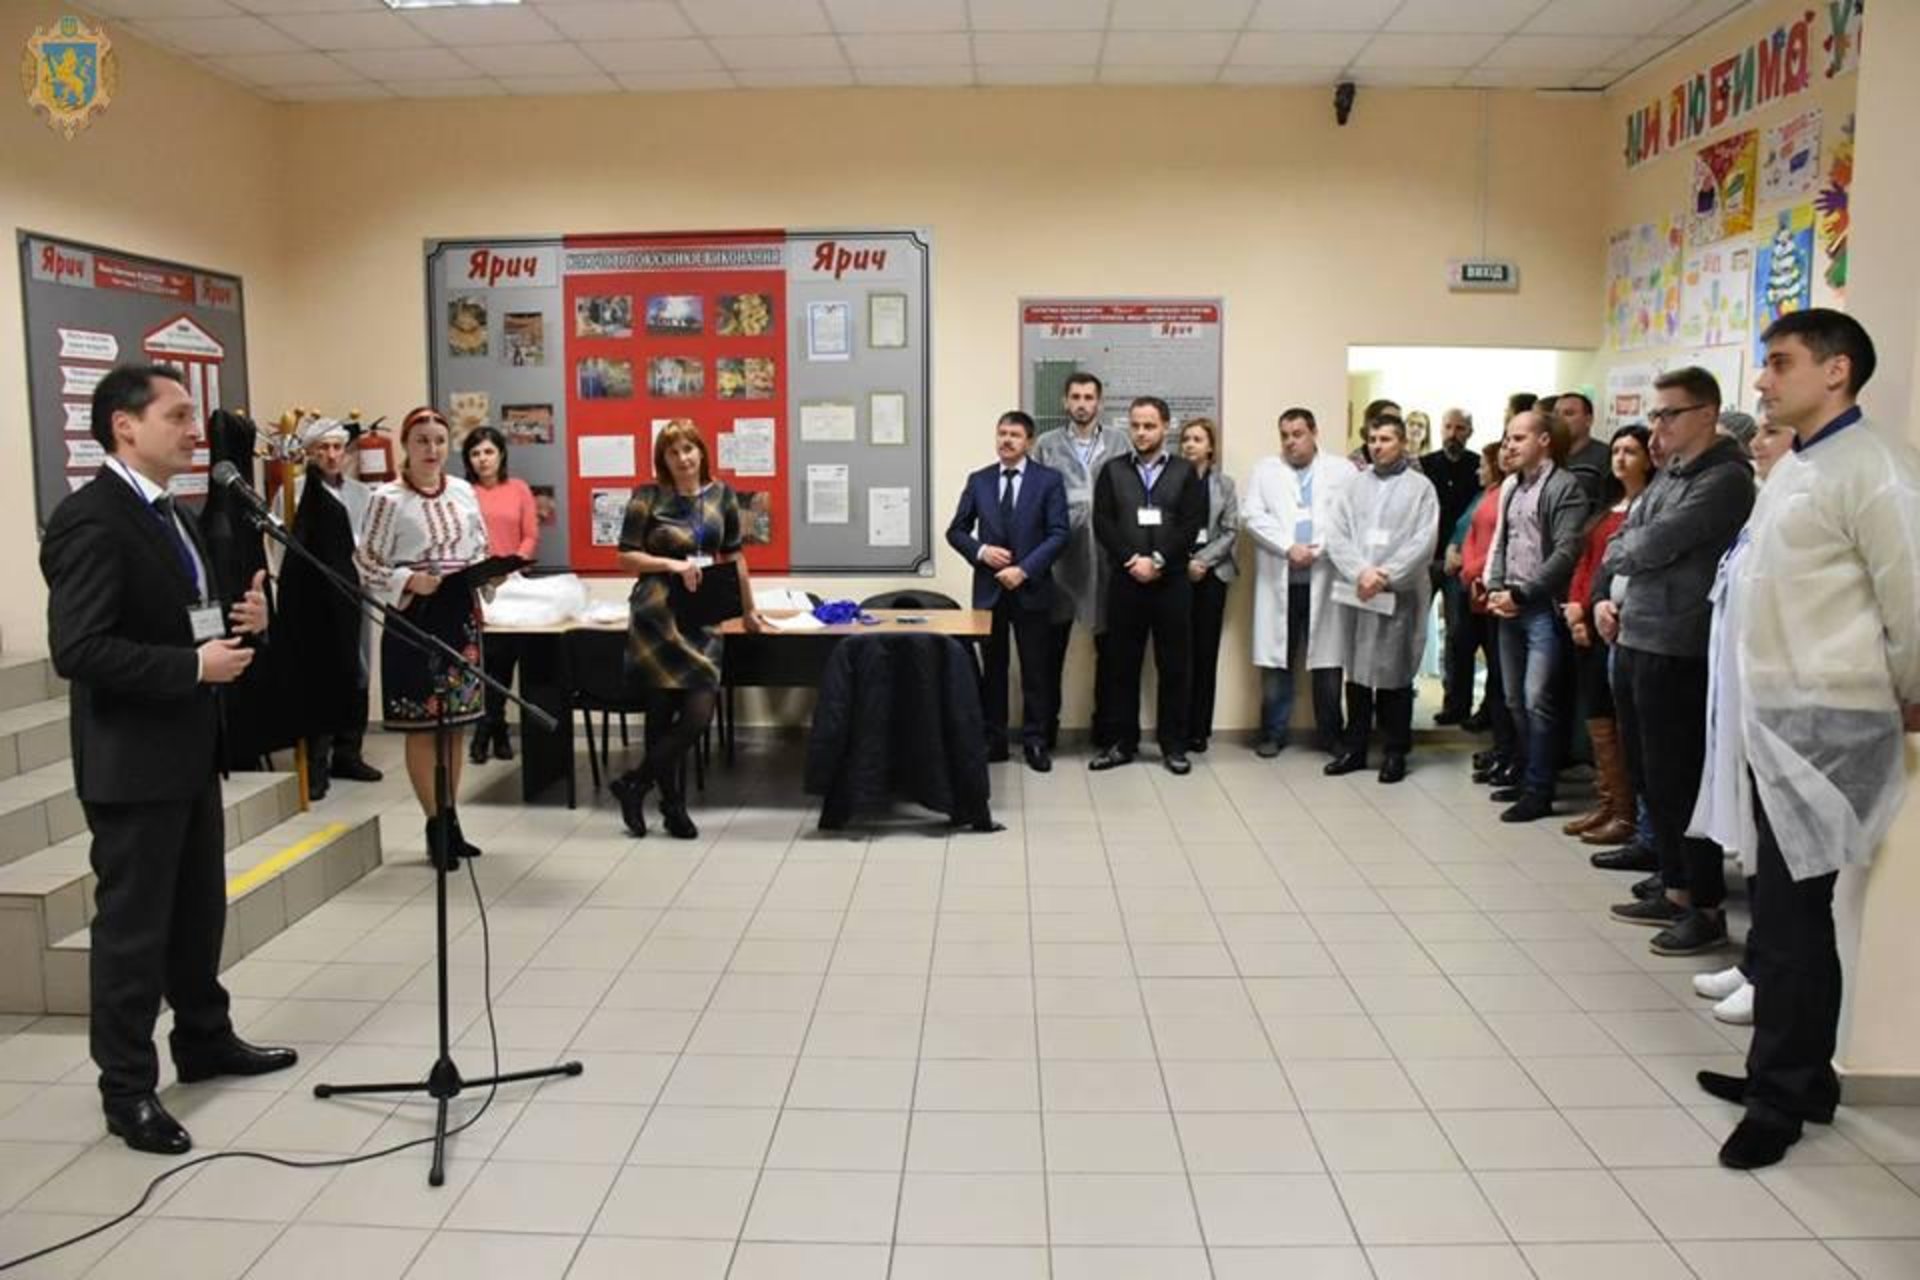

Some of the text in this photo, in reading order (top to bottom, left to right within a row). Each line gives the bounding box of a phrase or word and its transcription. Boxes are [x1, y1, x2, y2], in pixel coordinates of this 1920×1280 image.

[1625, 97, 1661, 167] МИ
[1667, 20, 1809, 147] ЛЮБИМО
[41, 245, 84, 280] Ярич
[468, 248, 538, 286] Ярич
[813, 242, 887, 279] Ярич
[1161, 323, 1194, 339] Ярич
